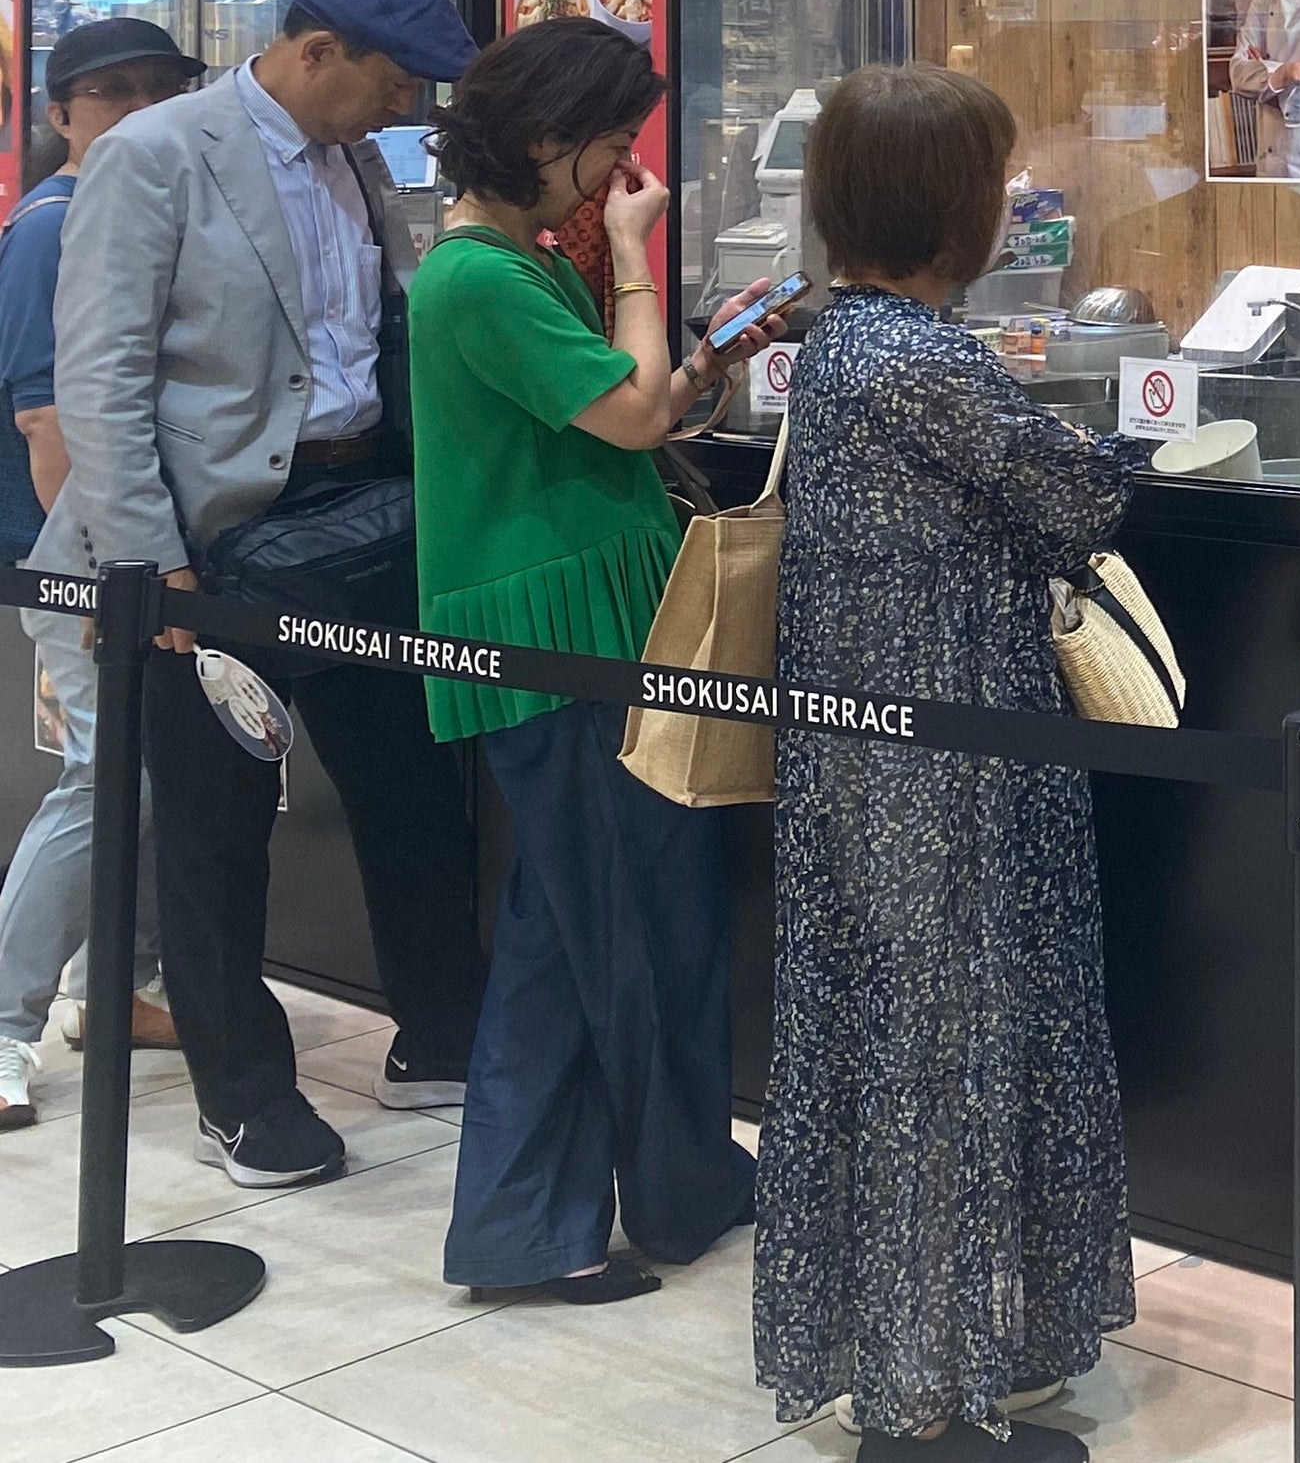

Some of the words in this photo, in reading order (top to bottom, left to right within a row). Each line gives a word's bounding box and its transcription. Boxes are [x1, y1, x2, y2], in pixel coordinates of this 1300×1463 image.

[278, 615, 391, 660] SHOKUSAI
[399, 635, 501, 679] TERRACE
[641, 672, 778, 718] SHOKUSAI
[788, 689, 914, 738] TERRACE
